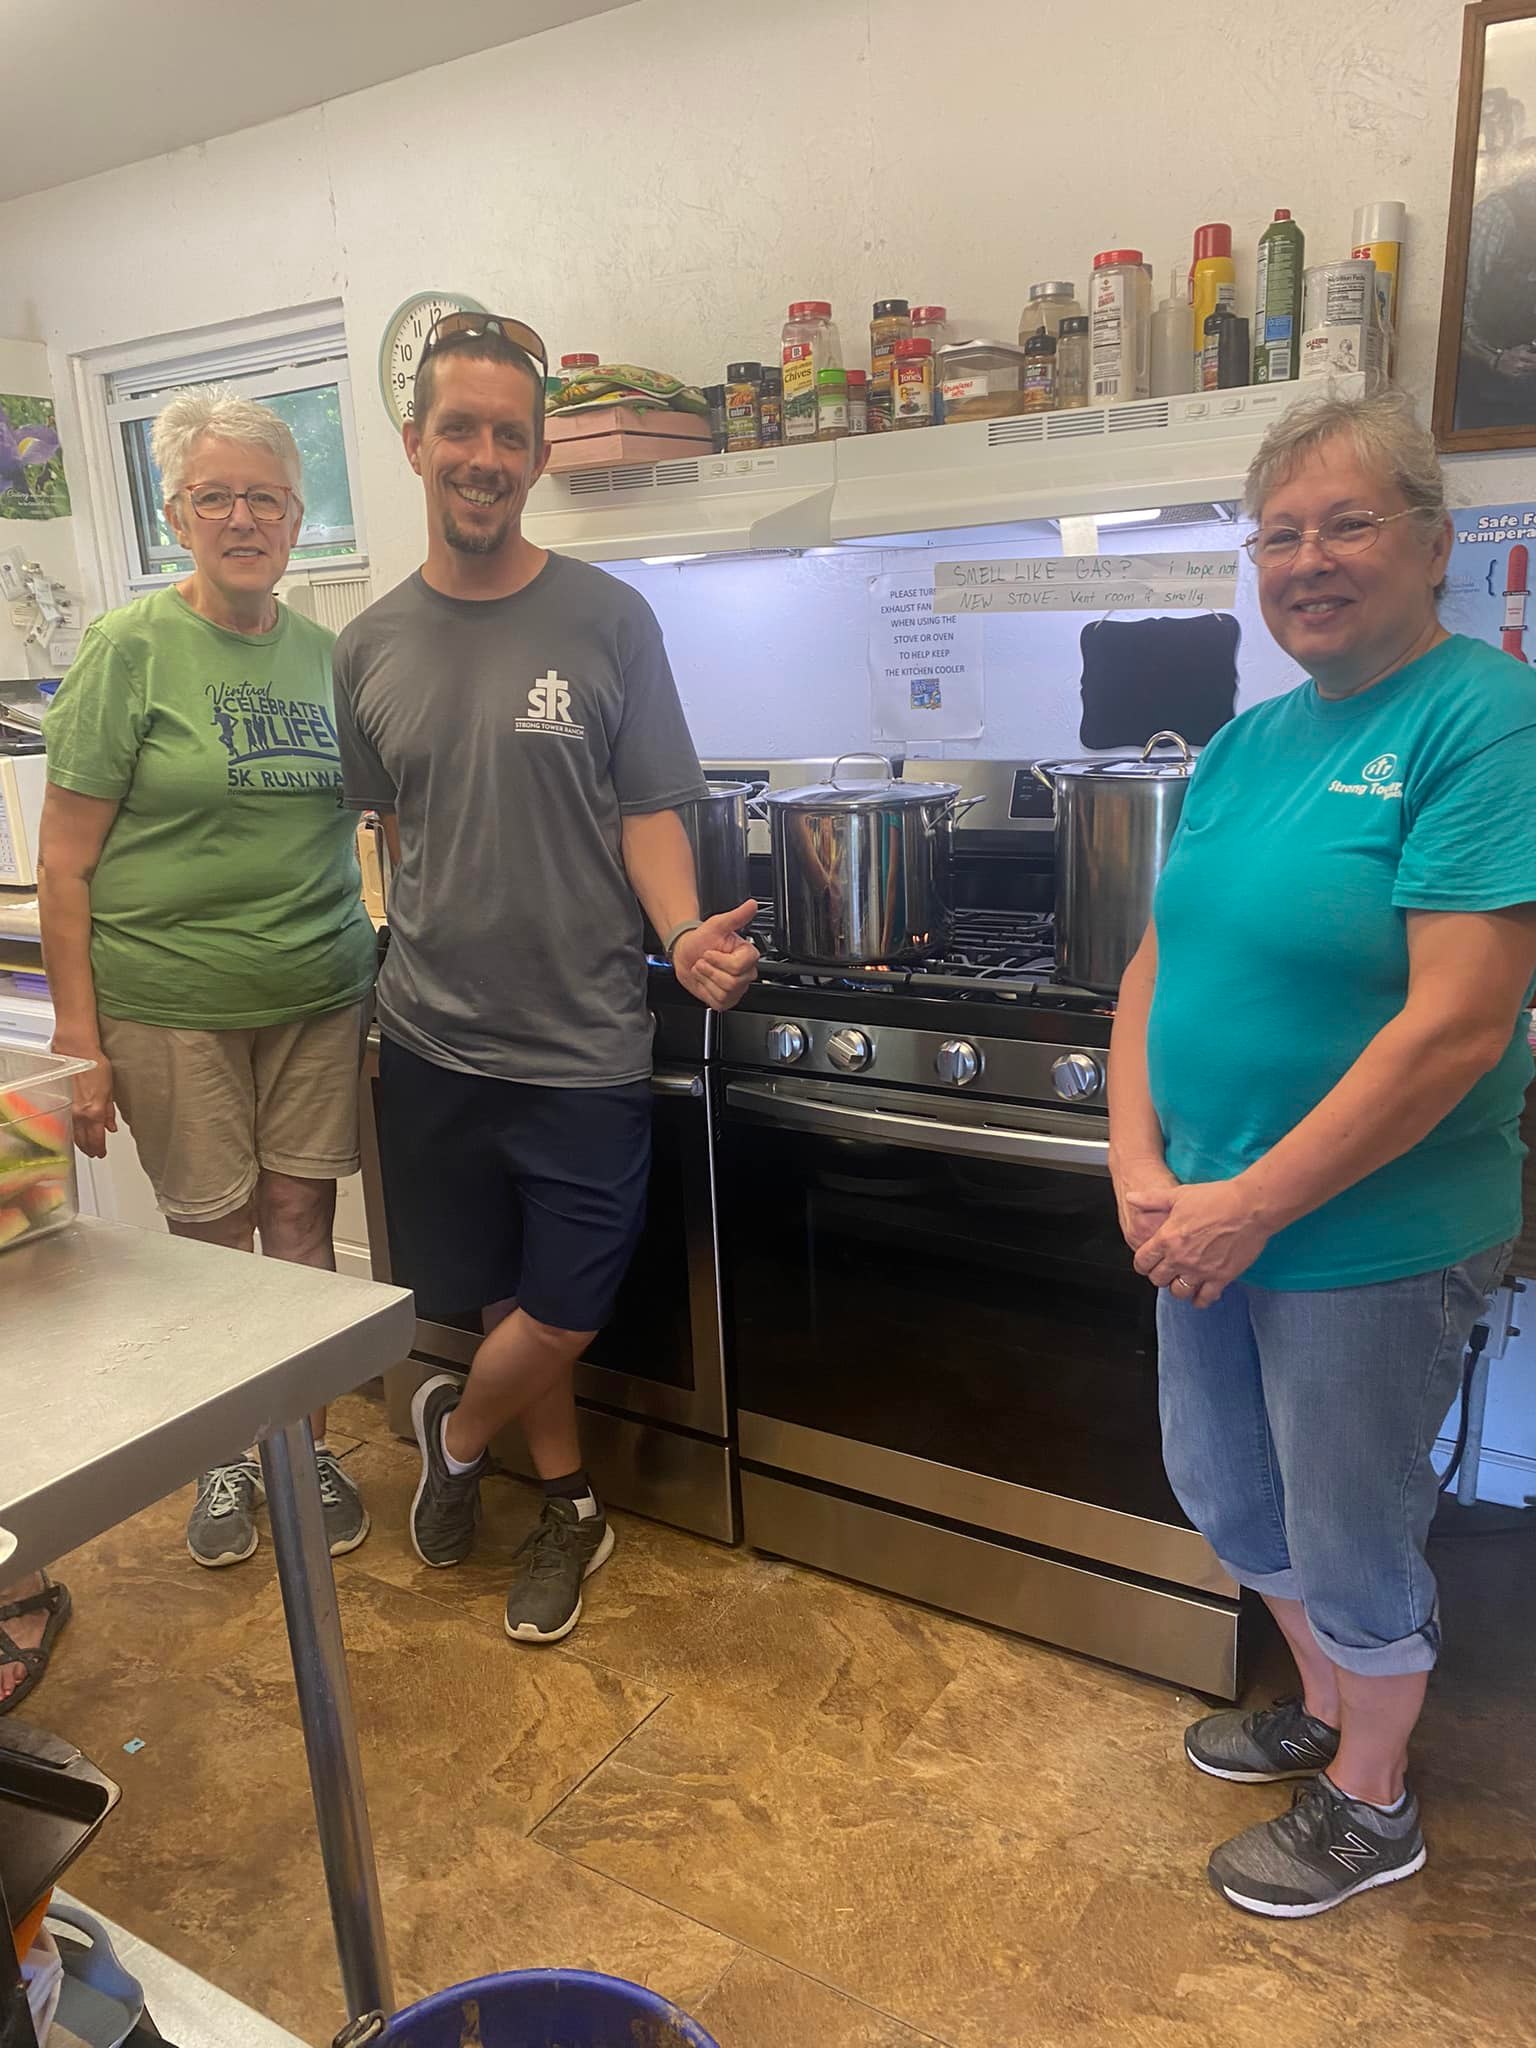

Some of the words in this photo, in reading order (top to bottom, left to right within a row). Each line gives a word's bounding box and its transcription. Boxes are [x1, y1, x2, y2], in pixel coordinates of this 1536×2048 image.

[430, 308, 441, 327] 12
[413, 320, 422, 338] 11
[400, 344, 413, 362] 10
[397, 373, 406, 389] 9
[407, 401, 415, 417] 8
[1478, 515, 1518, 529] Safe
[953, 565, 1006, 586] SMELL
[1015, 562, 1060, 580] LIKE
[1186, 561, 1214, 579] hope
[1218, 562, 1239, 576] not
[890, 588, 917, 599] PLEASE
[960, 592, 993, 609] NEW
[1105, 592, 1135, 602] room
[881, 603, 915, 614] EXHAUST
[917, 602, 932, 612] FAN
[890, 618, 916, 628] WHEN
[917, 616, 941, 626] USING
[942, 615, 957, 624] THE
[894, 634, 919, 645] STOVE
[920, 634, 931, 642] OR
[932, 632, 954, 641] OVEN
[899, 651, 910, 660] TO
[911, 650, 930, 659] HELP
[932, 649, 950, 658] KEEP
[885, 668, 900, 677] THE
[901, 666, 933, 676] KITCHEN
[934, 664, 965, 674] COOLER
[205, 681, 272, 705] Virtual
[222, 697, 321, 720] CELEBRATE
[515, 721, 541, 729] STRONG
[541, 723, 563, 731] TOWER
[227, 768, 256, 787] 5K
[1328, 779, 1368, 796] Strong
